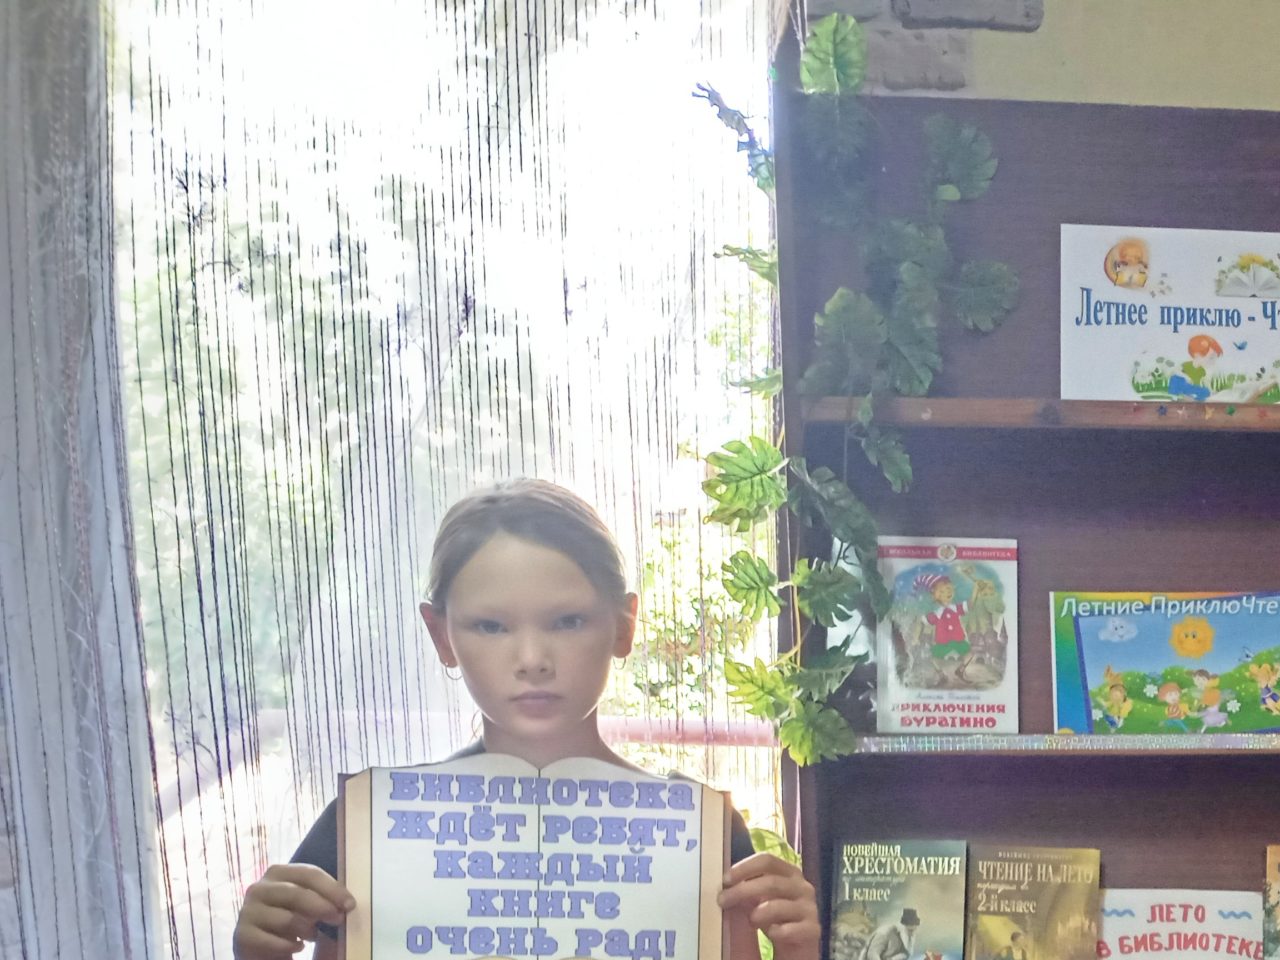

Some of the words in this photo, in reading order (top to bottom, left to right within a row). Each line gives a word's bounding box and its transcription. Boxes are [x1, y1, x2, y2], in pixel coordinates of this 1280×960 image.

[1075, 286, 1149, 326] Летнее
[1159, 304, 1242, 333] приклю
[1060, 597, 1144, 618] Летние
[842, 842, 901, 858] НОВЕЙШАЯ
[842, 856, 961, 876] ХРЕСТОМАТИЯ
[978, 860, 1033, 882] ЧТЕНИЕ
[853, 887, 891, 902] класс
[1146, 903, 1206, 925] ЛЕТО
